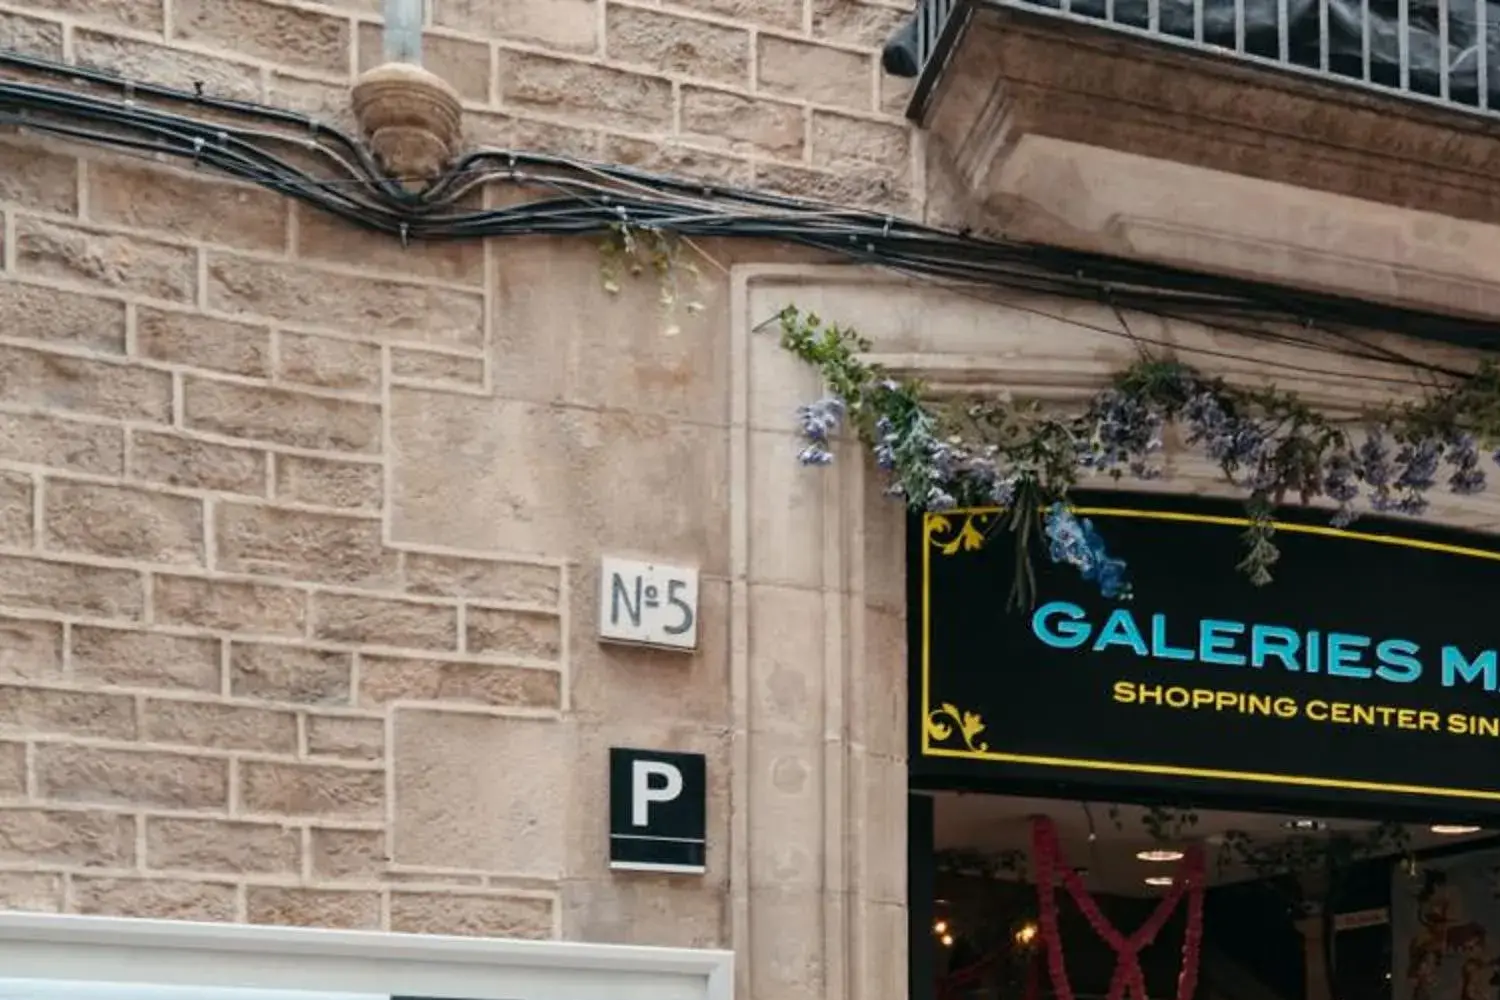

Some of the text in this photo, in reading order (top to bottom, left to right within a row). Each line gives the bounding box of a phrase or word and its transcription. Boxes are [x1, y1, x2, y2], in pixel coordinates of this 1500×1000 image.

[1032, 600, 1422, 686] GALERIES
[1113, 681, 1298, 718] SHOPPING
[1305, 700, 1440, 732] CENTER
[632, 760, 683, 827] P
